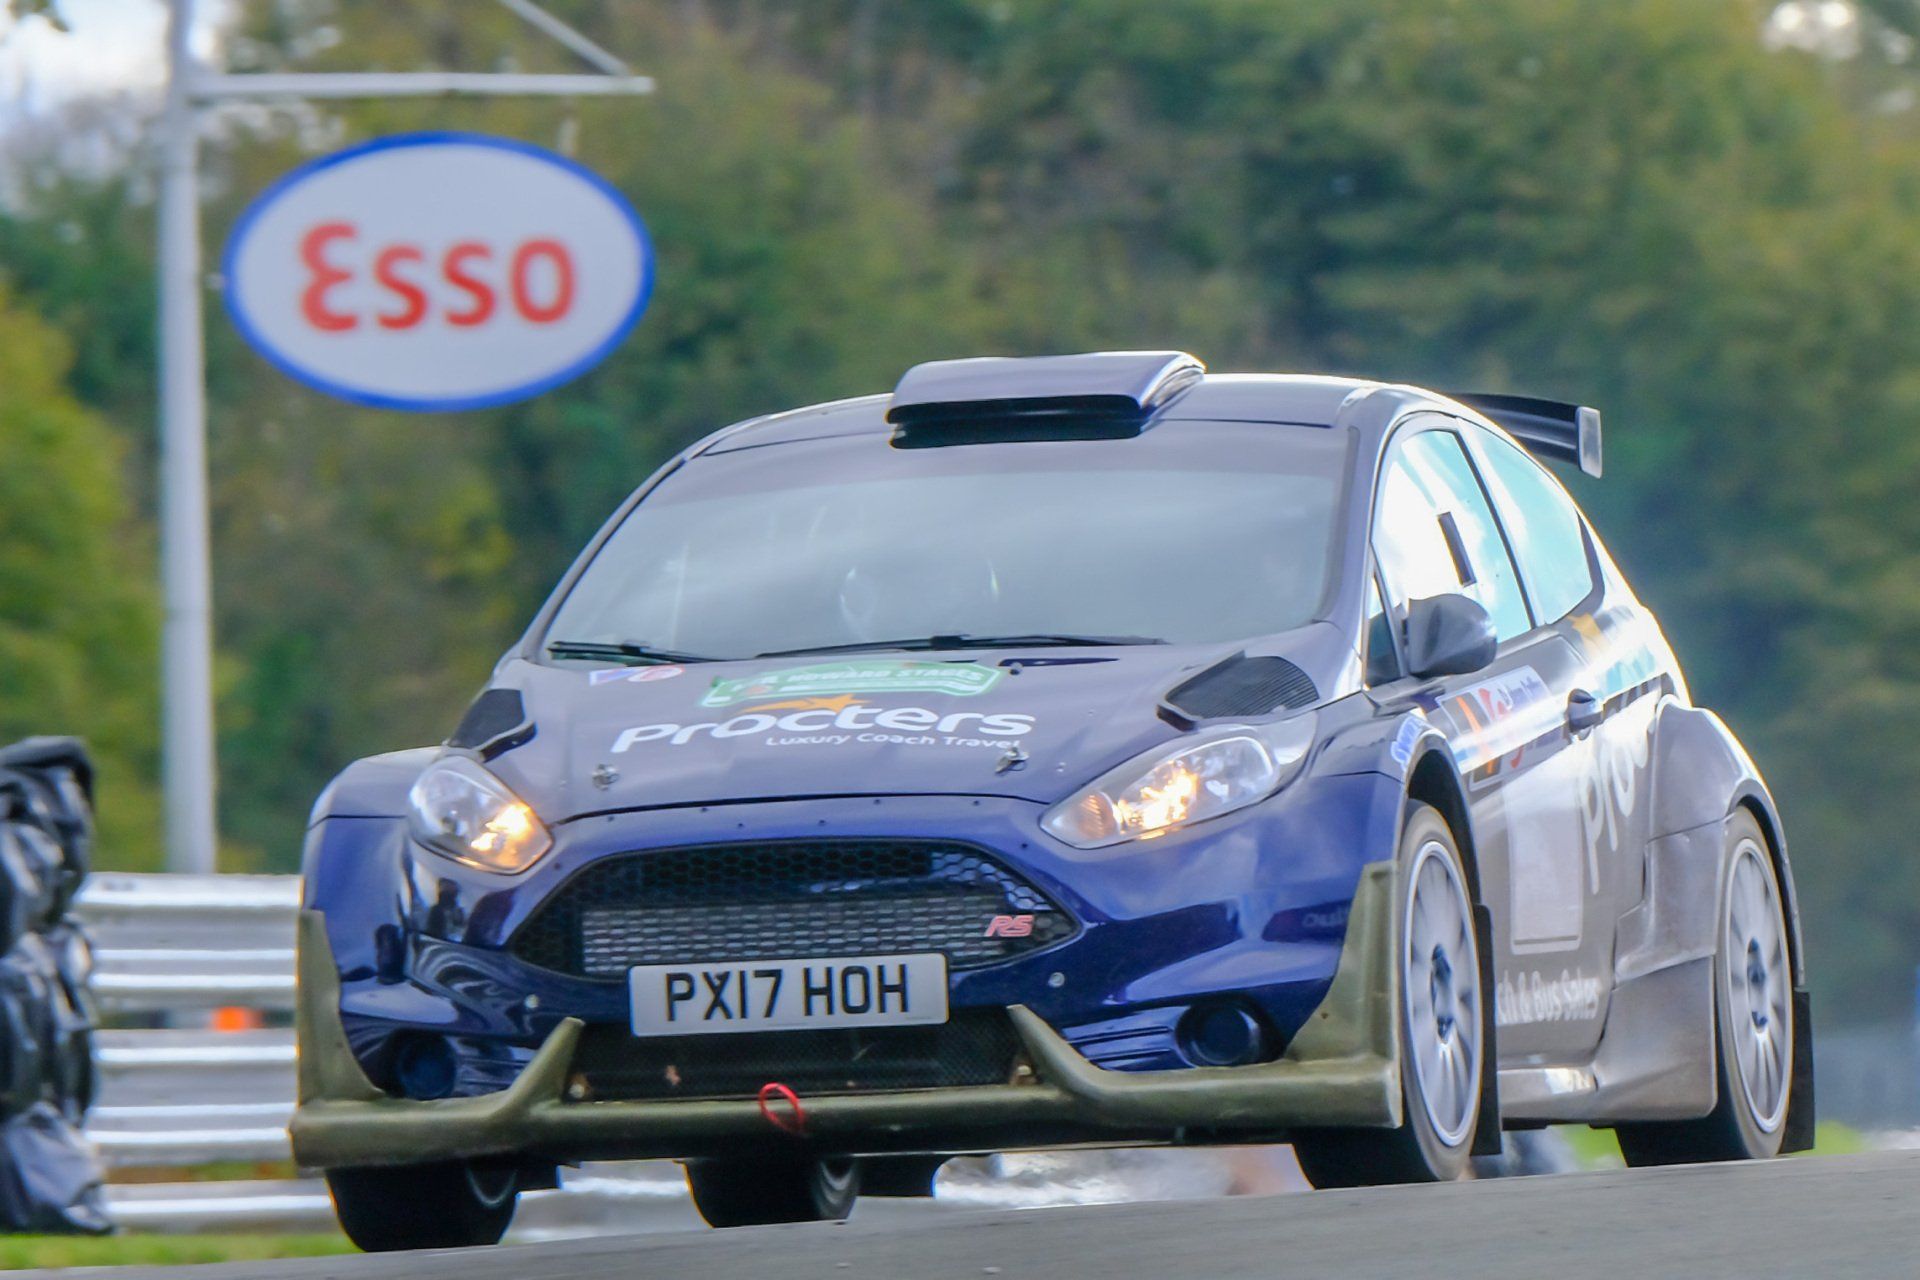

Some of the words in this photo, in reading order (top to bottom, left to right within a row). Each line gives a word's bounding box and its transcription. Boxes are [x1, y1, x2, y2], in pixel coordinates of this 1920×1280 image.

[610, 705, 1037, 753] procters
[765, 732, 851, 747] Luxury
[856, 731, 936, 746] Coach
[943, 735, 1021, 750] Travel
[984, 914, 1034, 938] RS
[665, 968, 784, 1022] PX17
[803, 963, 910, 1017] HOH
